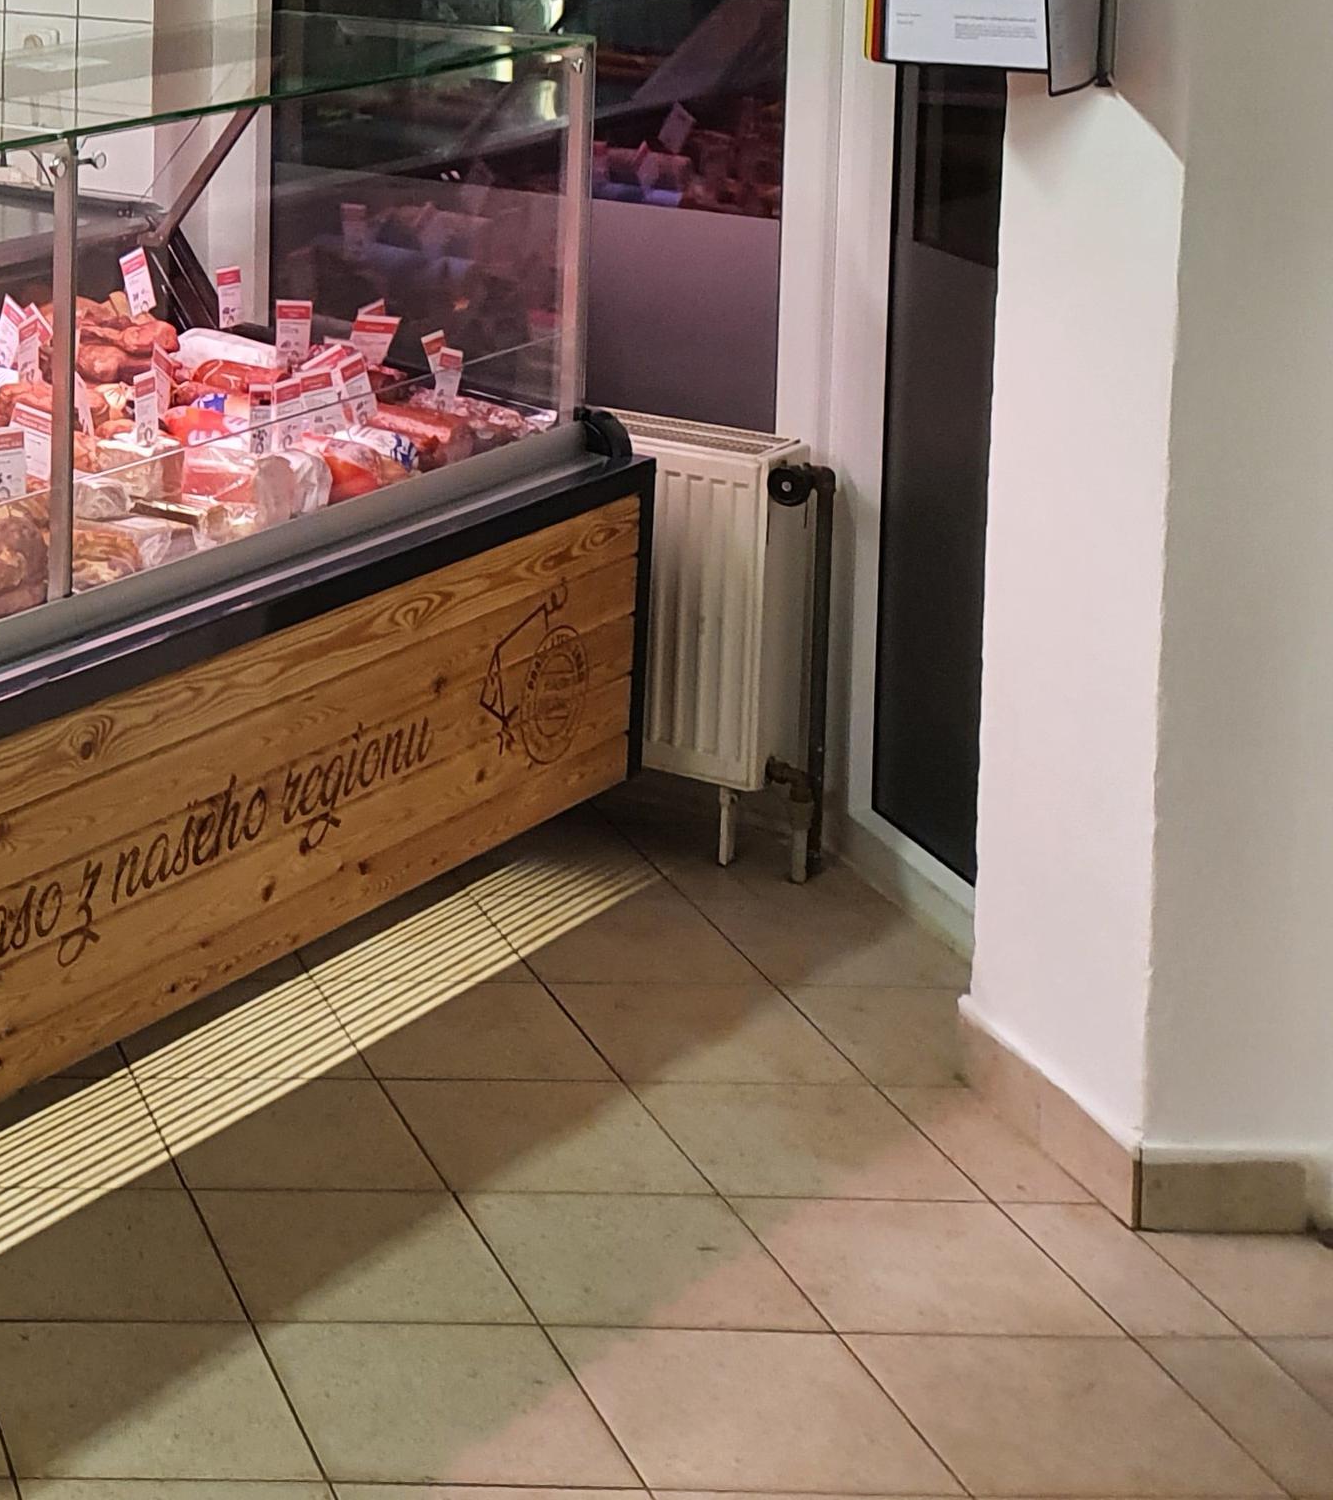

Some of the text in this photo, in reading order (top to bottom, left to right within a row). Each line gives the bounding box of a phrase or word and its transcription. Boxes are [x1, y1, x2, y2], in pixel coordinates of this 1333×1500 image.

[57, 859, 103, 967] z
[112, 774, 268, 904] našeho
[283, 716, 431, 857] regionu
